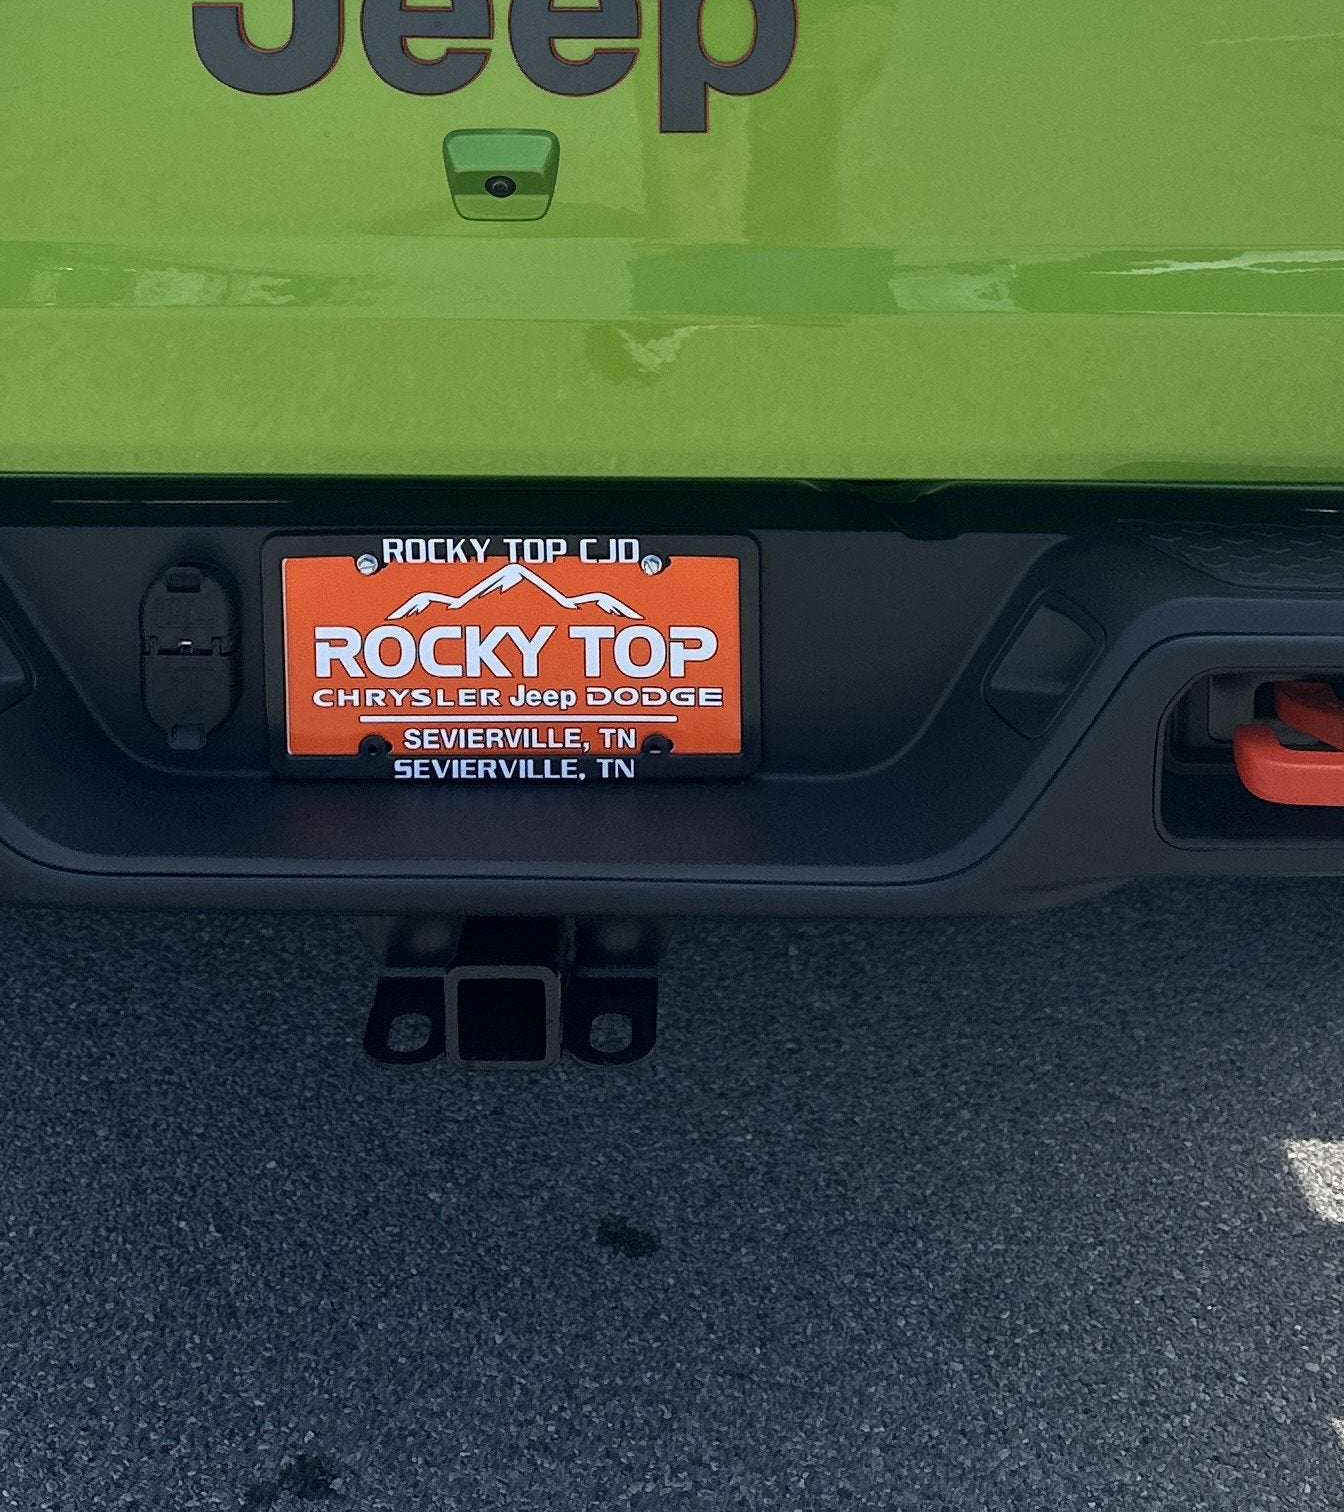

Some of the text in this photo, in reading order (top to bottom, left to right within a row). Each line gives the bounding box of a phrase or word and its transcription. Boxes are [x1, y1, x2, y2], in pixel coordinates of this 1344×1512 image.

[382, 538, 640, 564] ROCKY TOP CJD
[314, 625, 719, 679] ROCKY TOP
[312, 684, 724, 710] CHRYSLER Jeep DODGE
[403, 728, 636, 753] SEVIERVILLE, TN
[394, 759, 635, 781] SEVIERVILLE, TN
